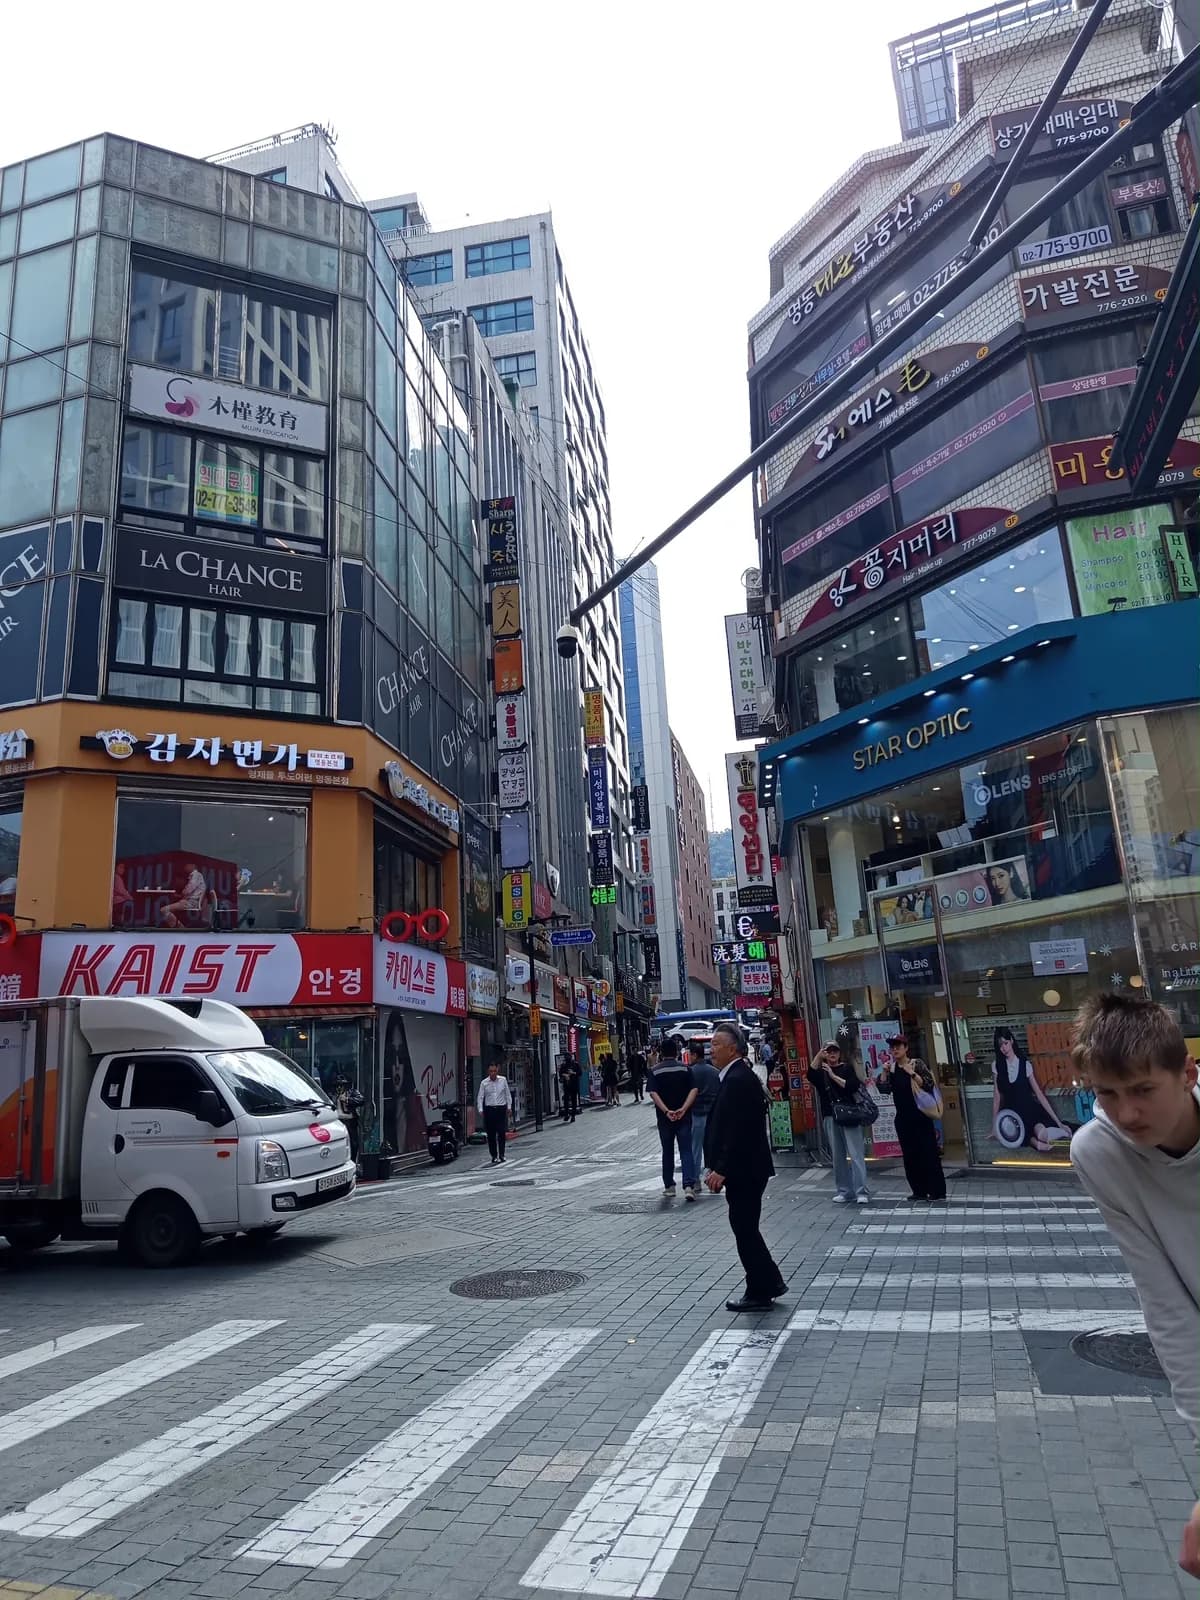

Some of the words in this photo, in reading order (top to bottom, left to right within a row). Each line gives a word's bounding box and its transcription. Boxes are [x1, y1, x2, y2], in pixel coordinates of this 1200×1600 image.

[1055, 126, 1110, 147] 775-9700
[1118, 180, 1161, 200] 부동산
[908, 198, 944, 234] 775-9700
[1022, 228, 1108, 262] 02-775-9700
[913, 227, 999, 306] 02-775-00
[1023, 265, 1140, 311] 가발전문
[1096, 294, 1148, 313] 776-2020
[935, 359, 971, 389] 776-2020
[207, 396, 298, 431] 木槿教育
[262, 428, 299, 440] EDUCATION
[198, 463, 255, 494] 임대문의
[1158, 471, 1185, 484] 9079
[195, 488, 257, 516] 02-777-3548
[1006, 516, 1018, 527] 3F
[1092, 521, 1148, 543] Hair
[505, 520, 517, 564] うらない
[961, 526, 998, 553] 777-9079
[0, 544, 46, 609] CE
[140, 550, 170, 573] LA
[175, 550, 304, 592] CHANCE
[1171, 534, 1193, 588] HAIR
[208, 583, 243, 599] HAIR
[496, 590, 515, 633] 美人
[0, 615, 20, 641] IR
[736, 640, 757, 694] 반지대학
[742, 703, 757, 713] 4F
[145, 732, 301, 772] 감자면가
[852, 734, 903, 772] STAR
[905, 707, 973, 750] OPTIC
[591, 886, 616, 905] 상품권
[58, 943, 277, 996] KAIST
[308, 966, 362, 996] 안경
[386, 950, 436, 994] 카이스트
[743, 973, 769, 985] 부동산
[768, 942, 782, 999] 미용실
